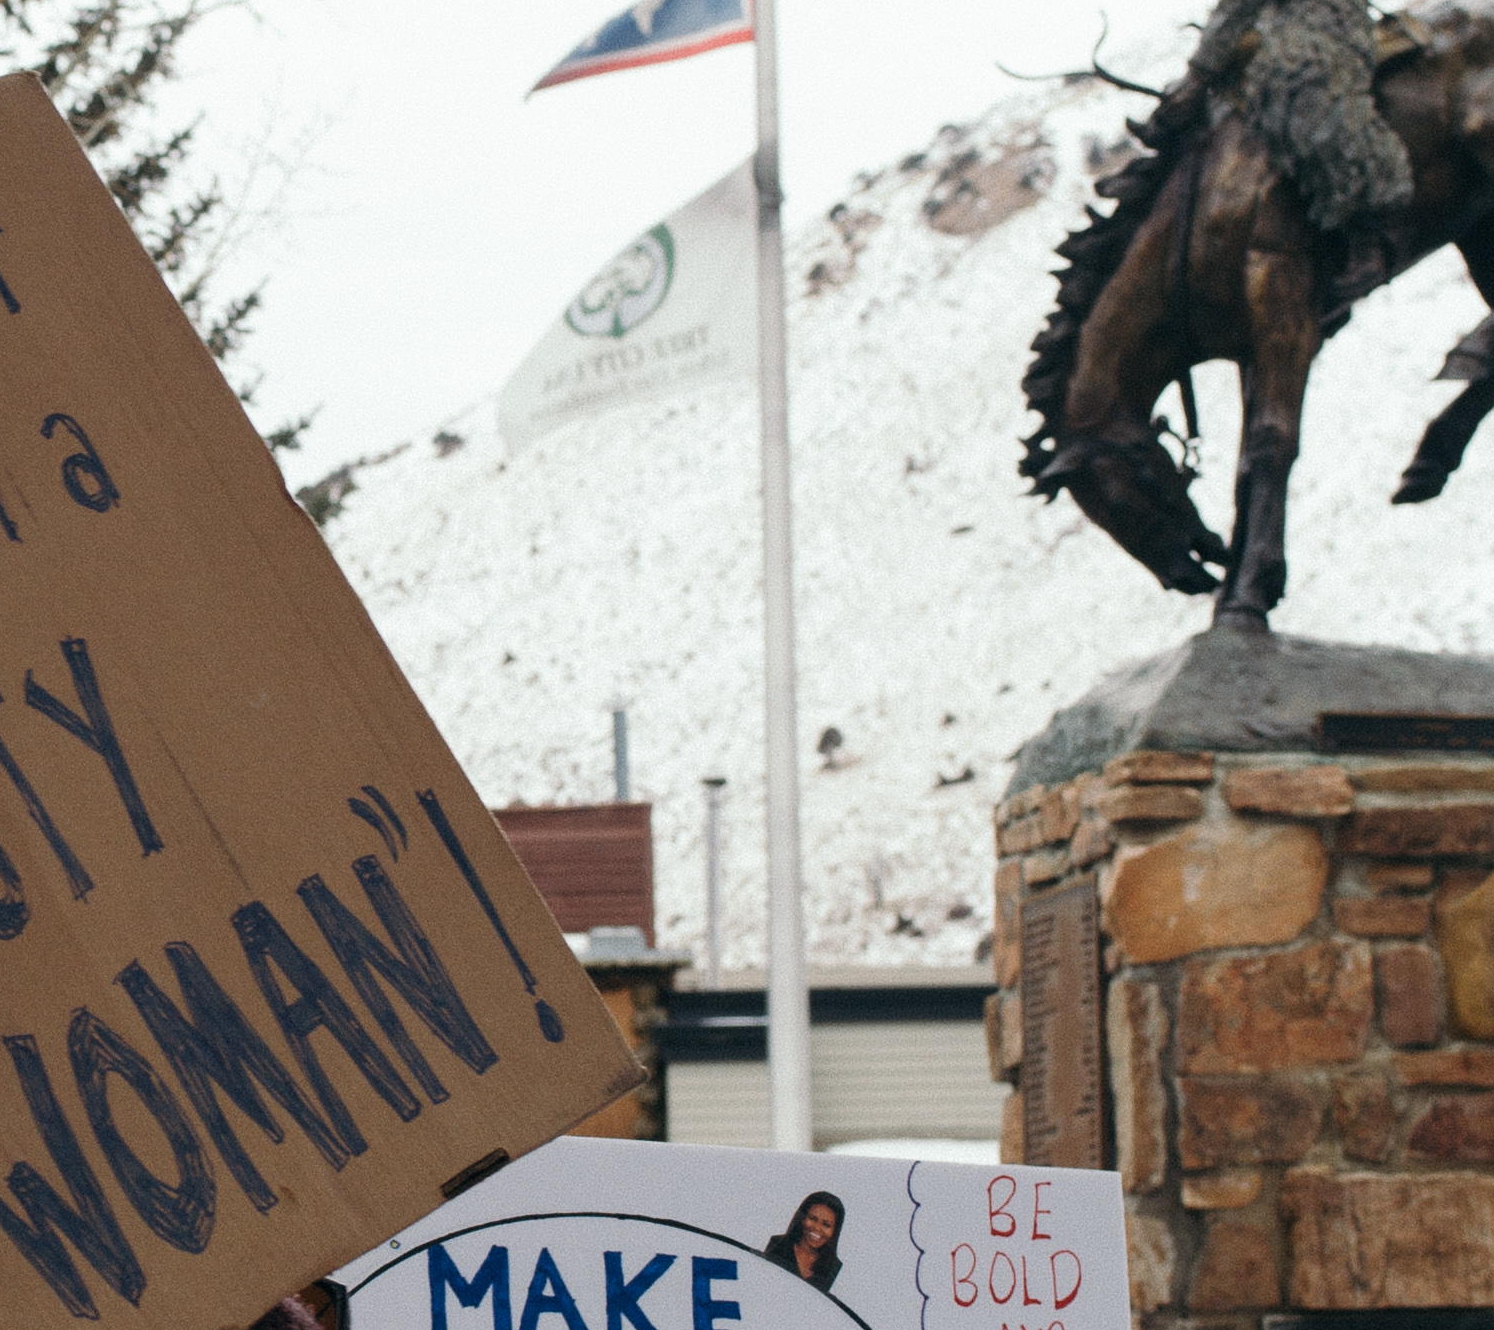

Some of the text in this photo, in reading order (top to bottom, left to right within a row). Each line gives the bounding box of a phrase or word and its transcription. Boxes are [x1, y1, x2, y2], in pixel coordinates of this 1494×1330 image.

[41, 412, 120, 517] a
[987, 1174, 1052, 1240] BE
[951, 1243, 1082, 1310] BOLD
